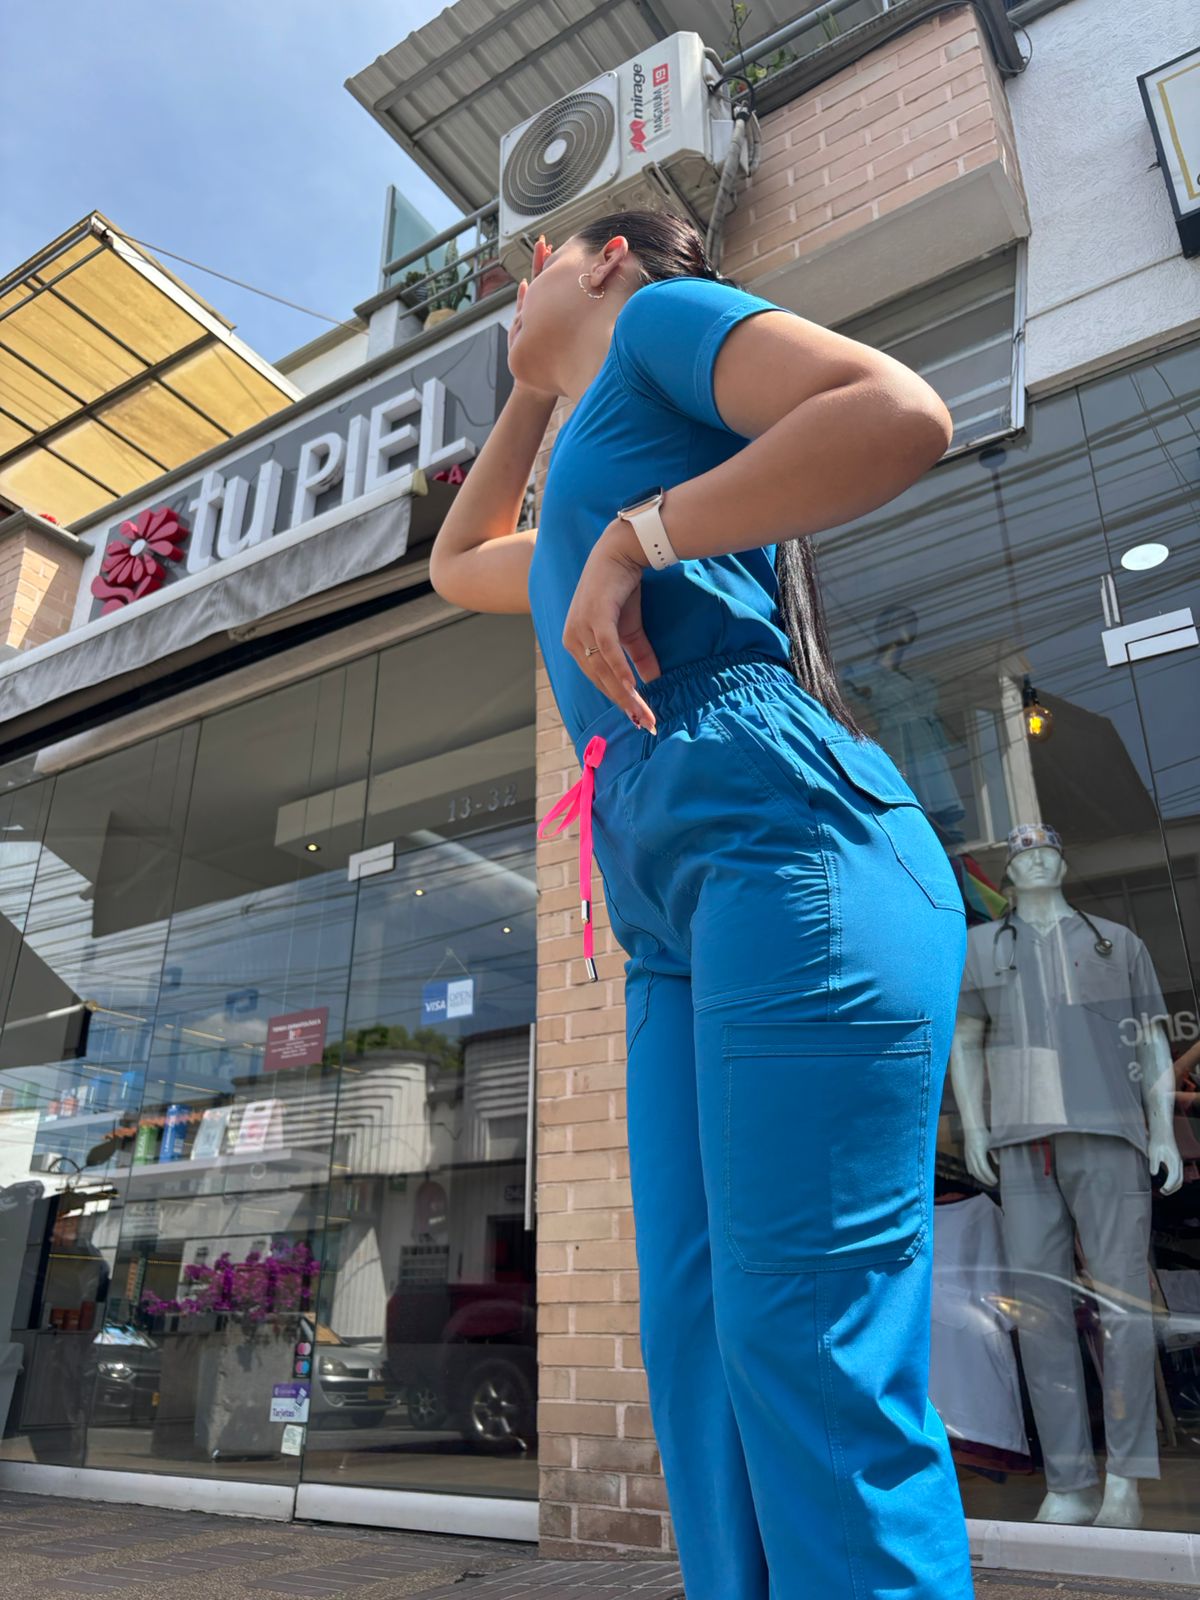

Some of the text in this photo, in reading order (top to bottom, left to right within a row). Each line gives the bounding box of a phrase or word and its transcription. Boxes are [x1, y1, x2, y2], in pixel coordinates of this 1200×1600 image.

[629, 64, 645, 119] mirage
[653, 87, 663, 133] MAGNUM
[186, 377, 477, 575] tu PIEL
[425, 1000, 446, 1012] VISA
[272, 1408, 295, 1419] Tarjetas
